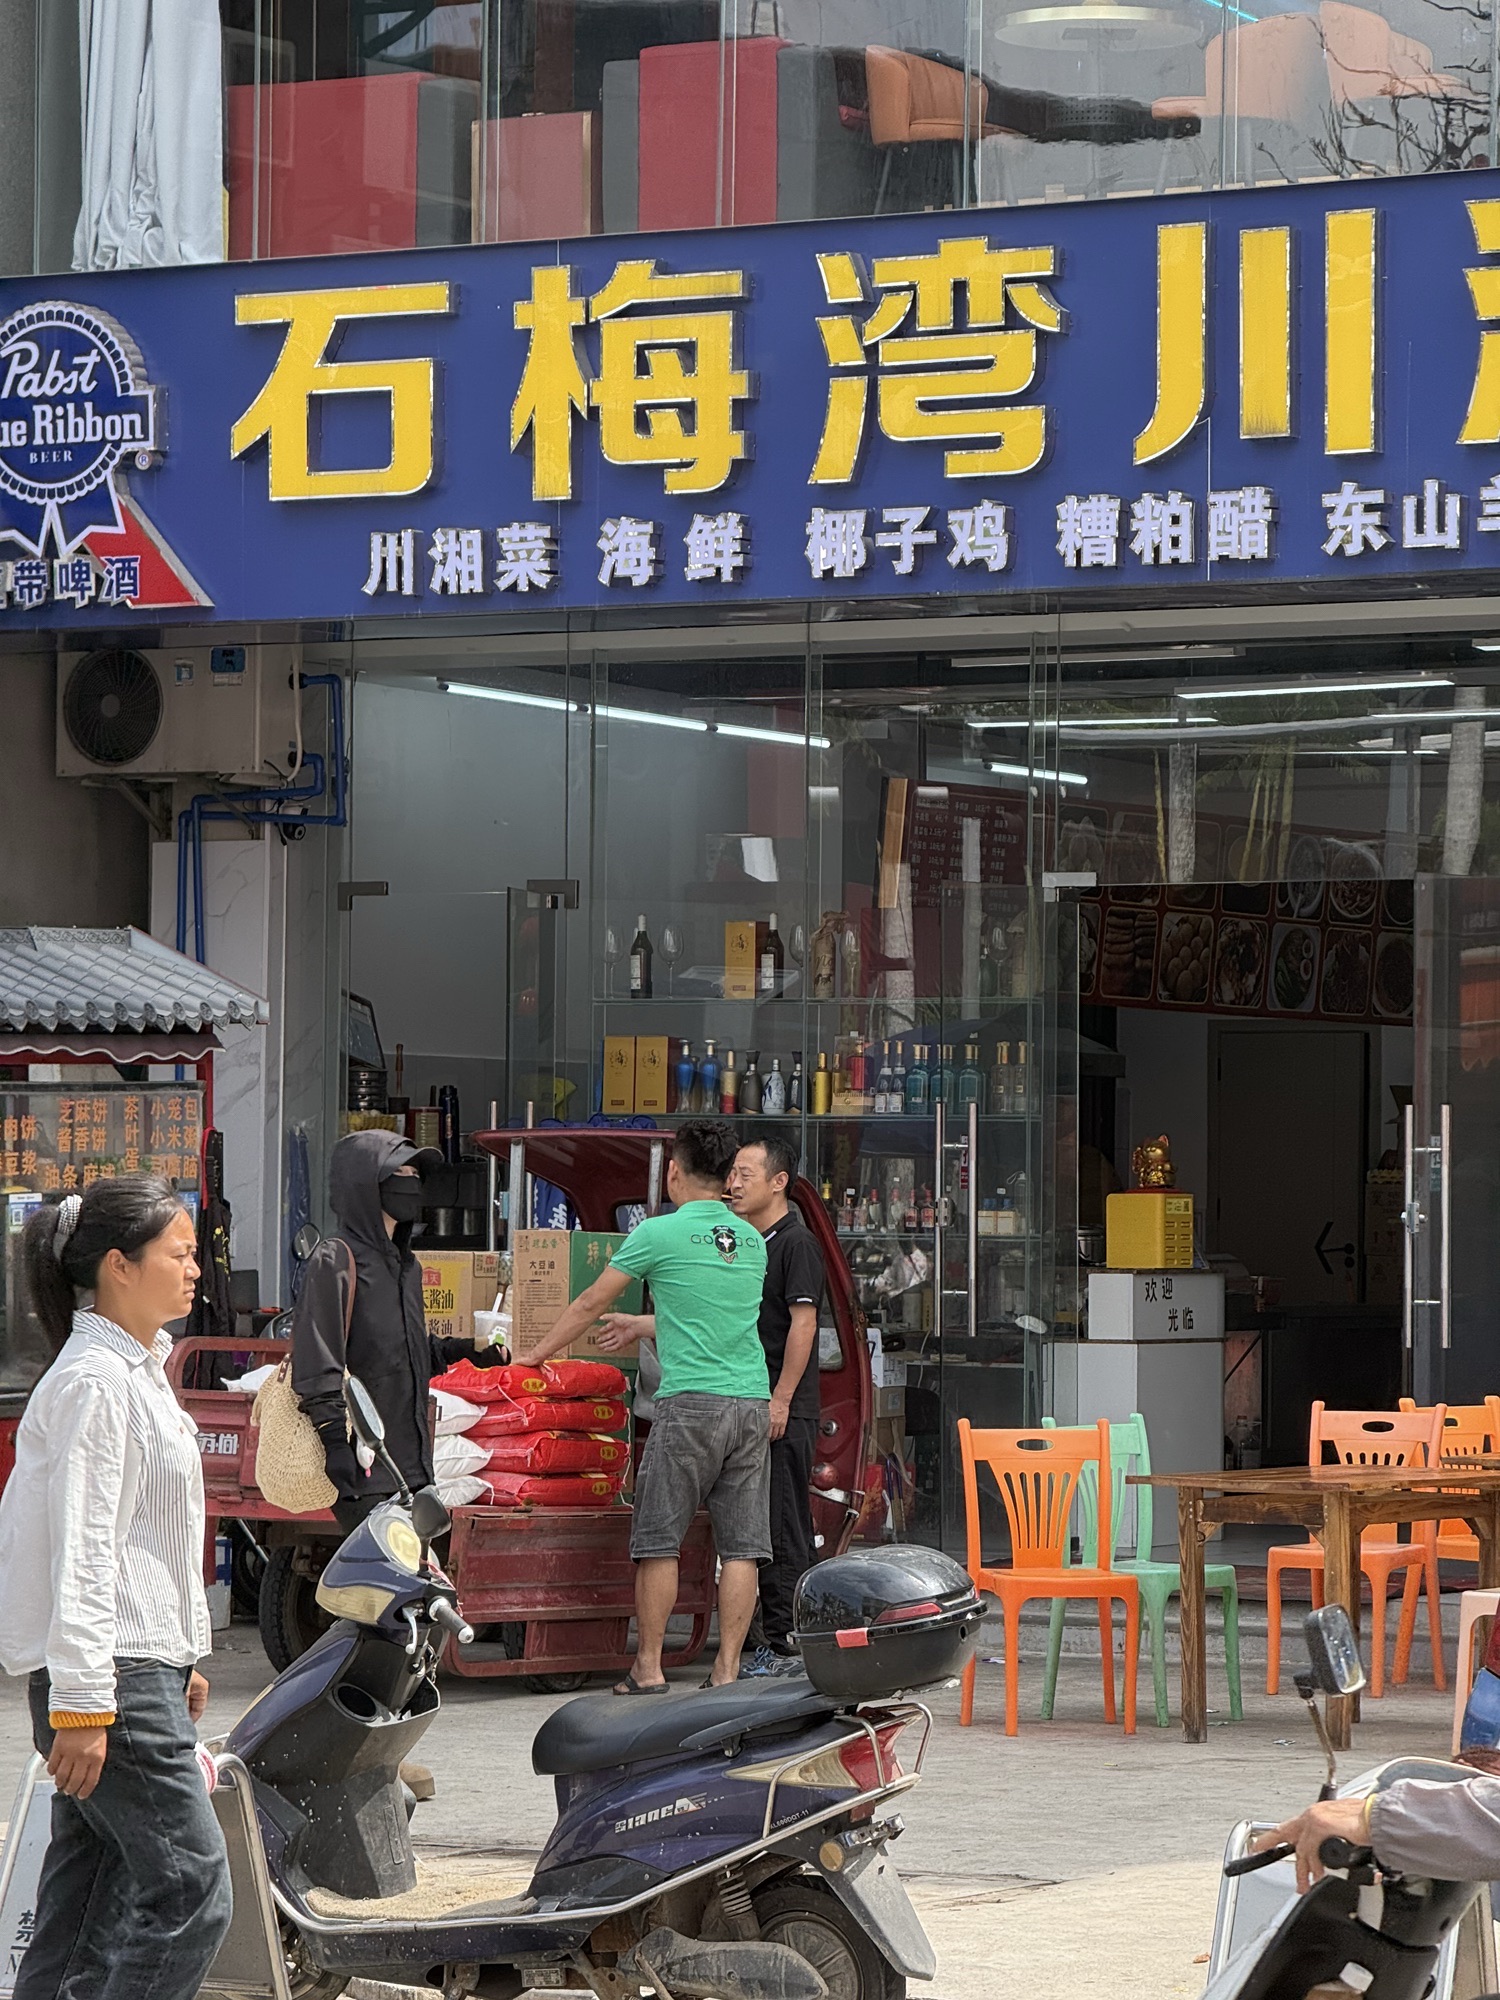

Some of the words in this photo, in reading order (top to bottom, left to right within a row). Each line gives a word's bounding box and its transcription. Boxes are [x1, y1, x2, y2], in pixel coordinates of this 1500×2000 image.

[230, 199, 1500, 502] 石梅湾川
[0, 341, 101, 400] Pabst
[32, 401, 145, 446] Ribbon
[29, 450, 74, 464] BEER
[361, 520, 554, 597] 川湘菜
[596, 511, 746, 587] 海鲜
[804, 499, 1011, 578] 椰子鸡
[1055, 485, 1274, 568] 糟粕醋
[0, 554, 142, 610] 带啤酒
[58, 1097, 108, 1124] 芝麻饼
[150, 1096, 198, 1122] 小笼包
[0, 1115, 37, 1142] 肉饼
[57, 1127, 107, 1153] 酱香饼
[124, 1096, 140, 1173] 茶叶蛋
[150, 1124, 198, 1150] 小米粥
[0, 1150, 38, 1177] 豆浆
[44, 1163, 79, 1190] 油条
[1144, 1277, 1174, 1303] 欢迎
[1168, 1306, 1194, 1332] 光临
